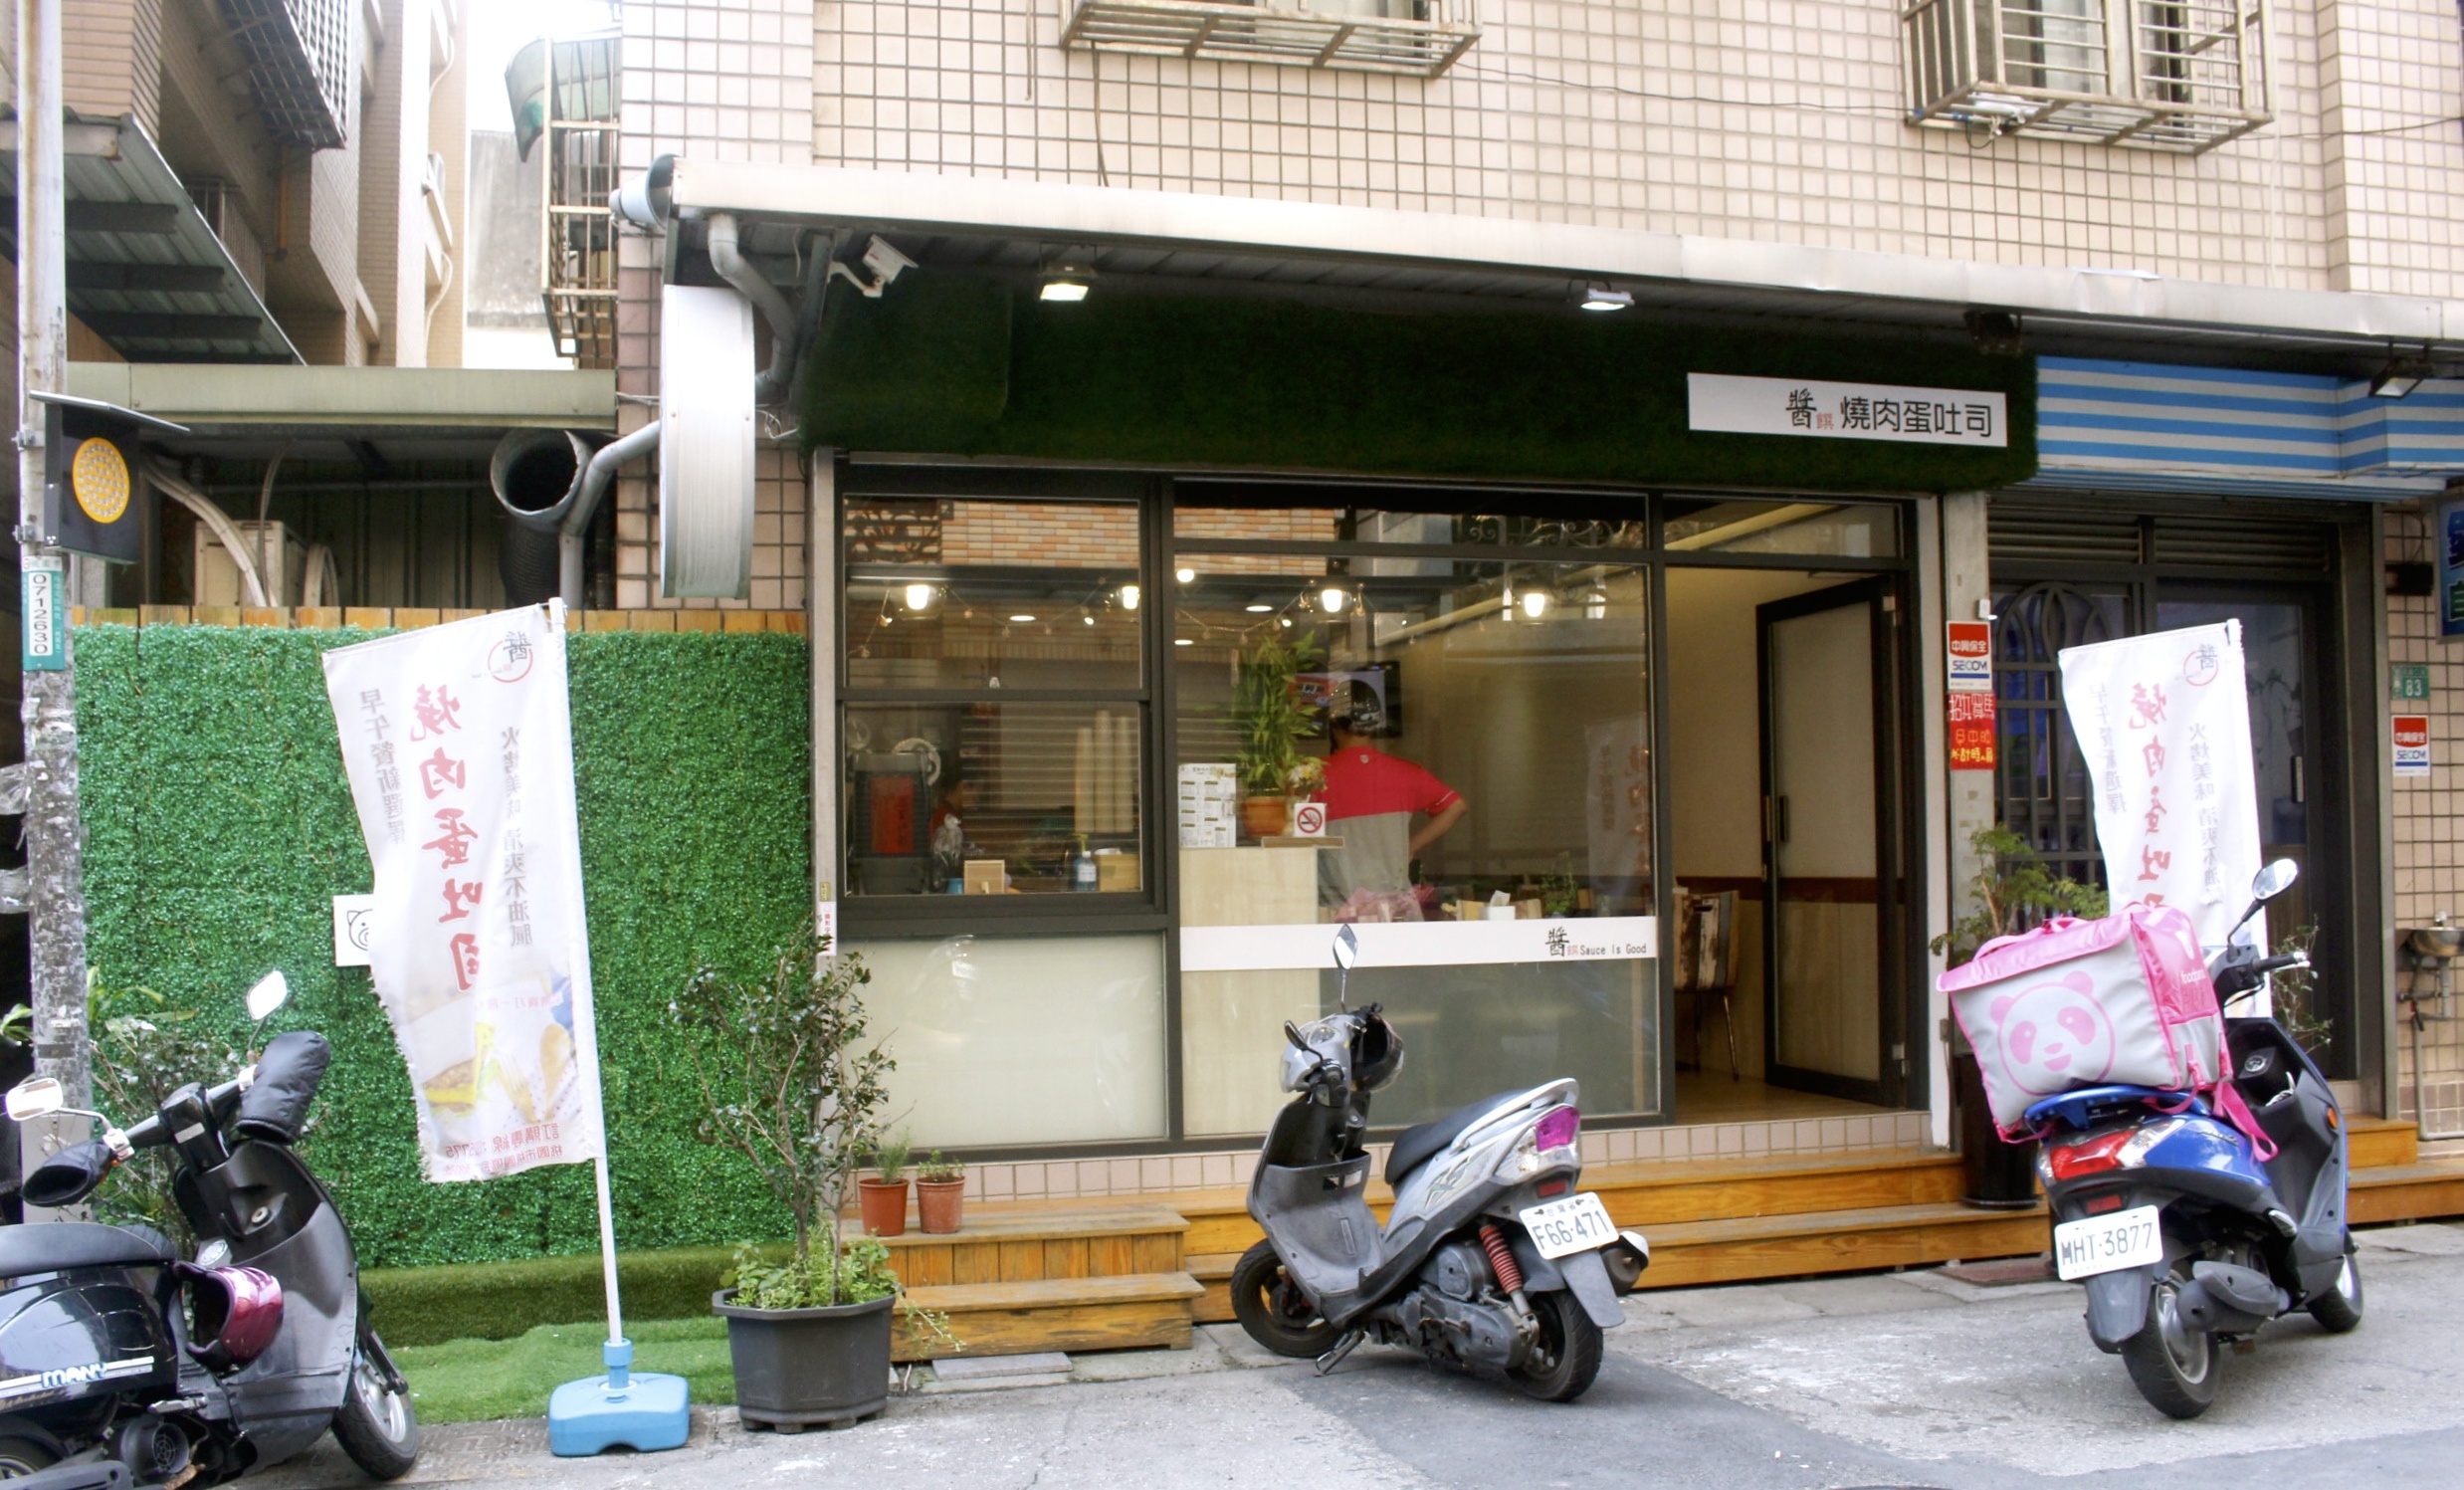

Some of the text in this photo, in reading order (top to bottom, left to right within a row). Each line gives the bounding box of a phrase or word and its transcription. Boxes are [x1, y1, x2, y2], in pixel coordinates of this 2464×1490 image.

[1840, 395, 1992, 438] 燒肉蛋吐司
[32, 573, 49, 655] 0712630
[1952, 660, 1988, 672] SECOM
[2405, 680, 2422, 697] 83
[2396, 750, 2426, 760] SECOM
[1580, 945, 1606, 956] Sauce
[1626, 944, 1647, 956] Good
